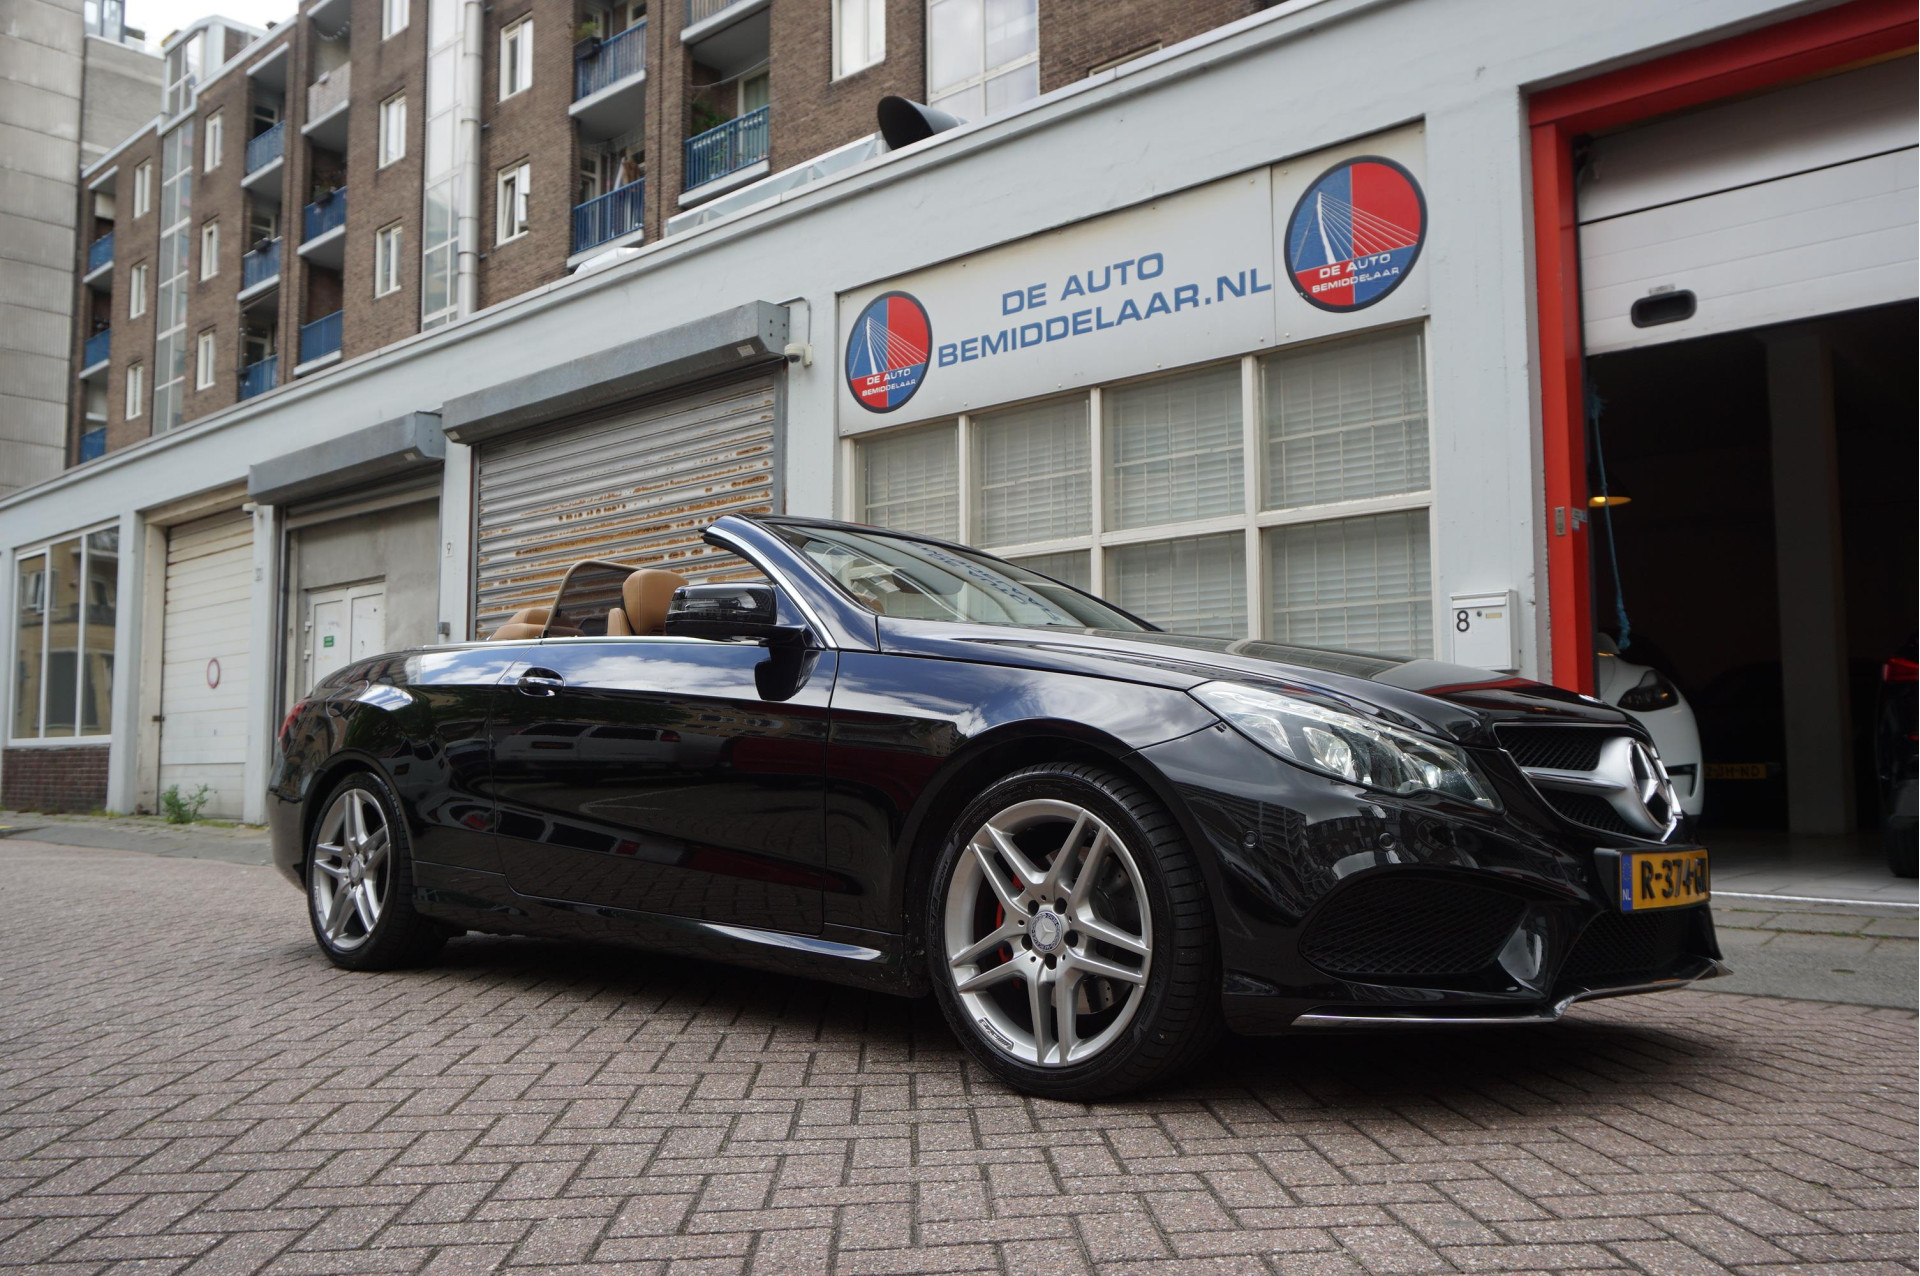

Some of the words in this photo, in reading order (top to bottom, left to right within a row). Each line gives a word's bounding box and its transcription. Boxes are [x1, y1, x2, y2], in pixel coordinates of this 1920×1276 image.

[1319, 265, 1341, 279] DE
[1346, 253, 1391, 272] AUTO
[1001, 282, 1048, 316] DE
[1060, 252, 1164, 301] AUTO
[1312, 267, 1400, 293] BEMIDDELAAR
[937, 268, 1272, 368] BEMIDDELAAR.NL
[861, 379, 917, 397] BEMIDDELAAR
[866, 375, 881, 386] DE
[883, 368, 911, 382] AUTO
[1456, 610, 1470, 632] 8
[1622, 888, 1632, 901] NL
